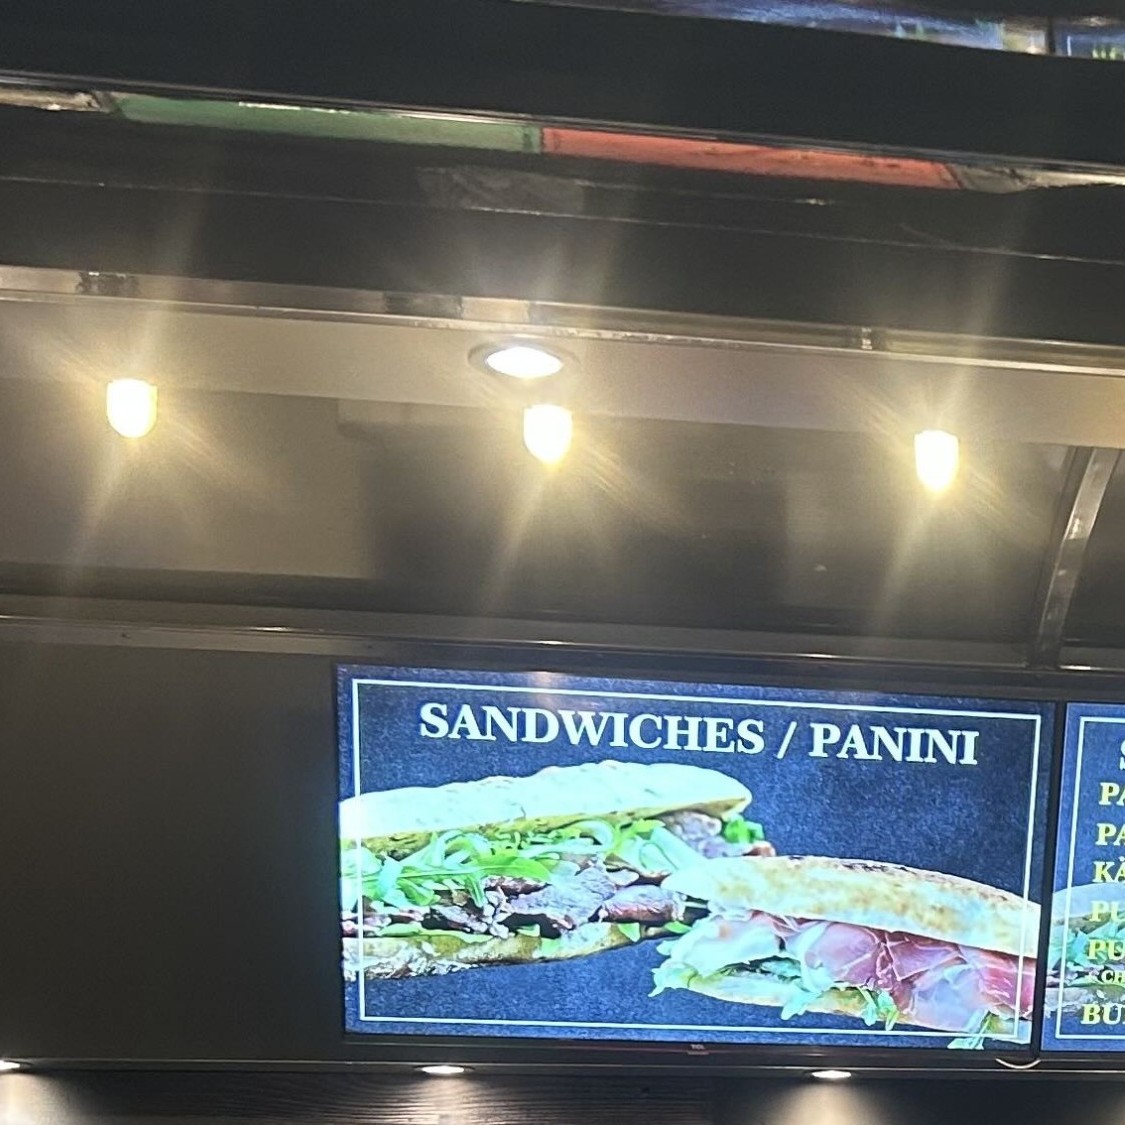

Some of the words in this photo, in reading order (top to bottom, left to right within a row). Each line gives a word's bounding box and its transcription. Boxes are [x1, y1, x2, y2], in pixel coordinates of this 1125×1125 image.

[419, 703, 765, 754] SANDWICHES
[776, 721, 798, 760] /
[808, 722, 979, 765] PANINI
